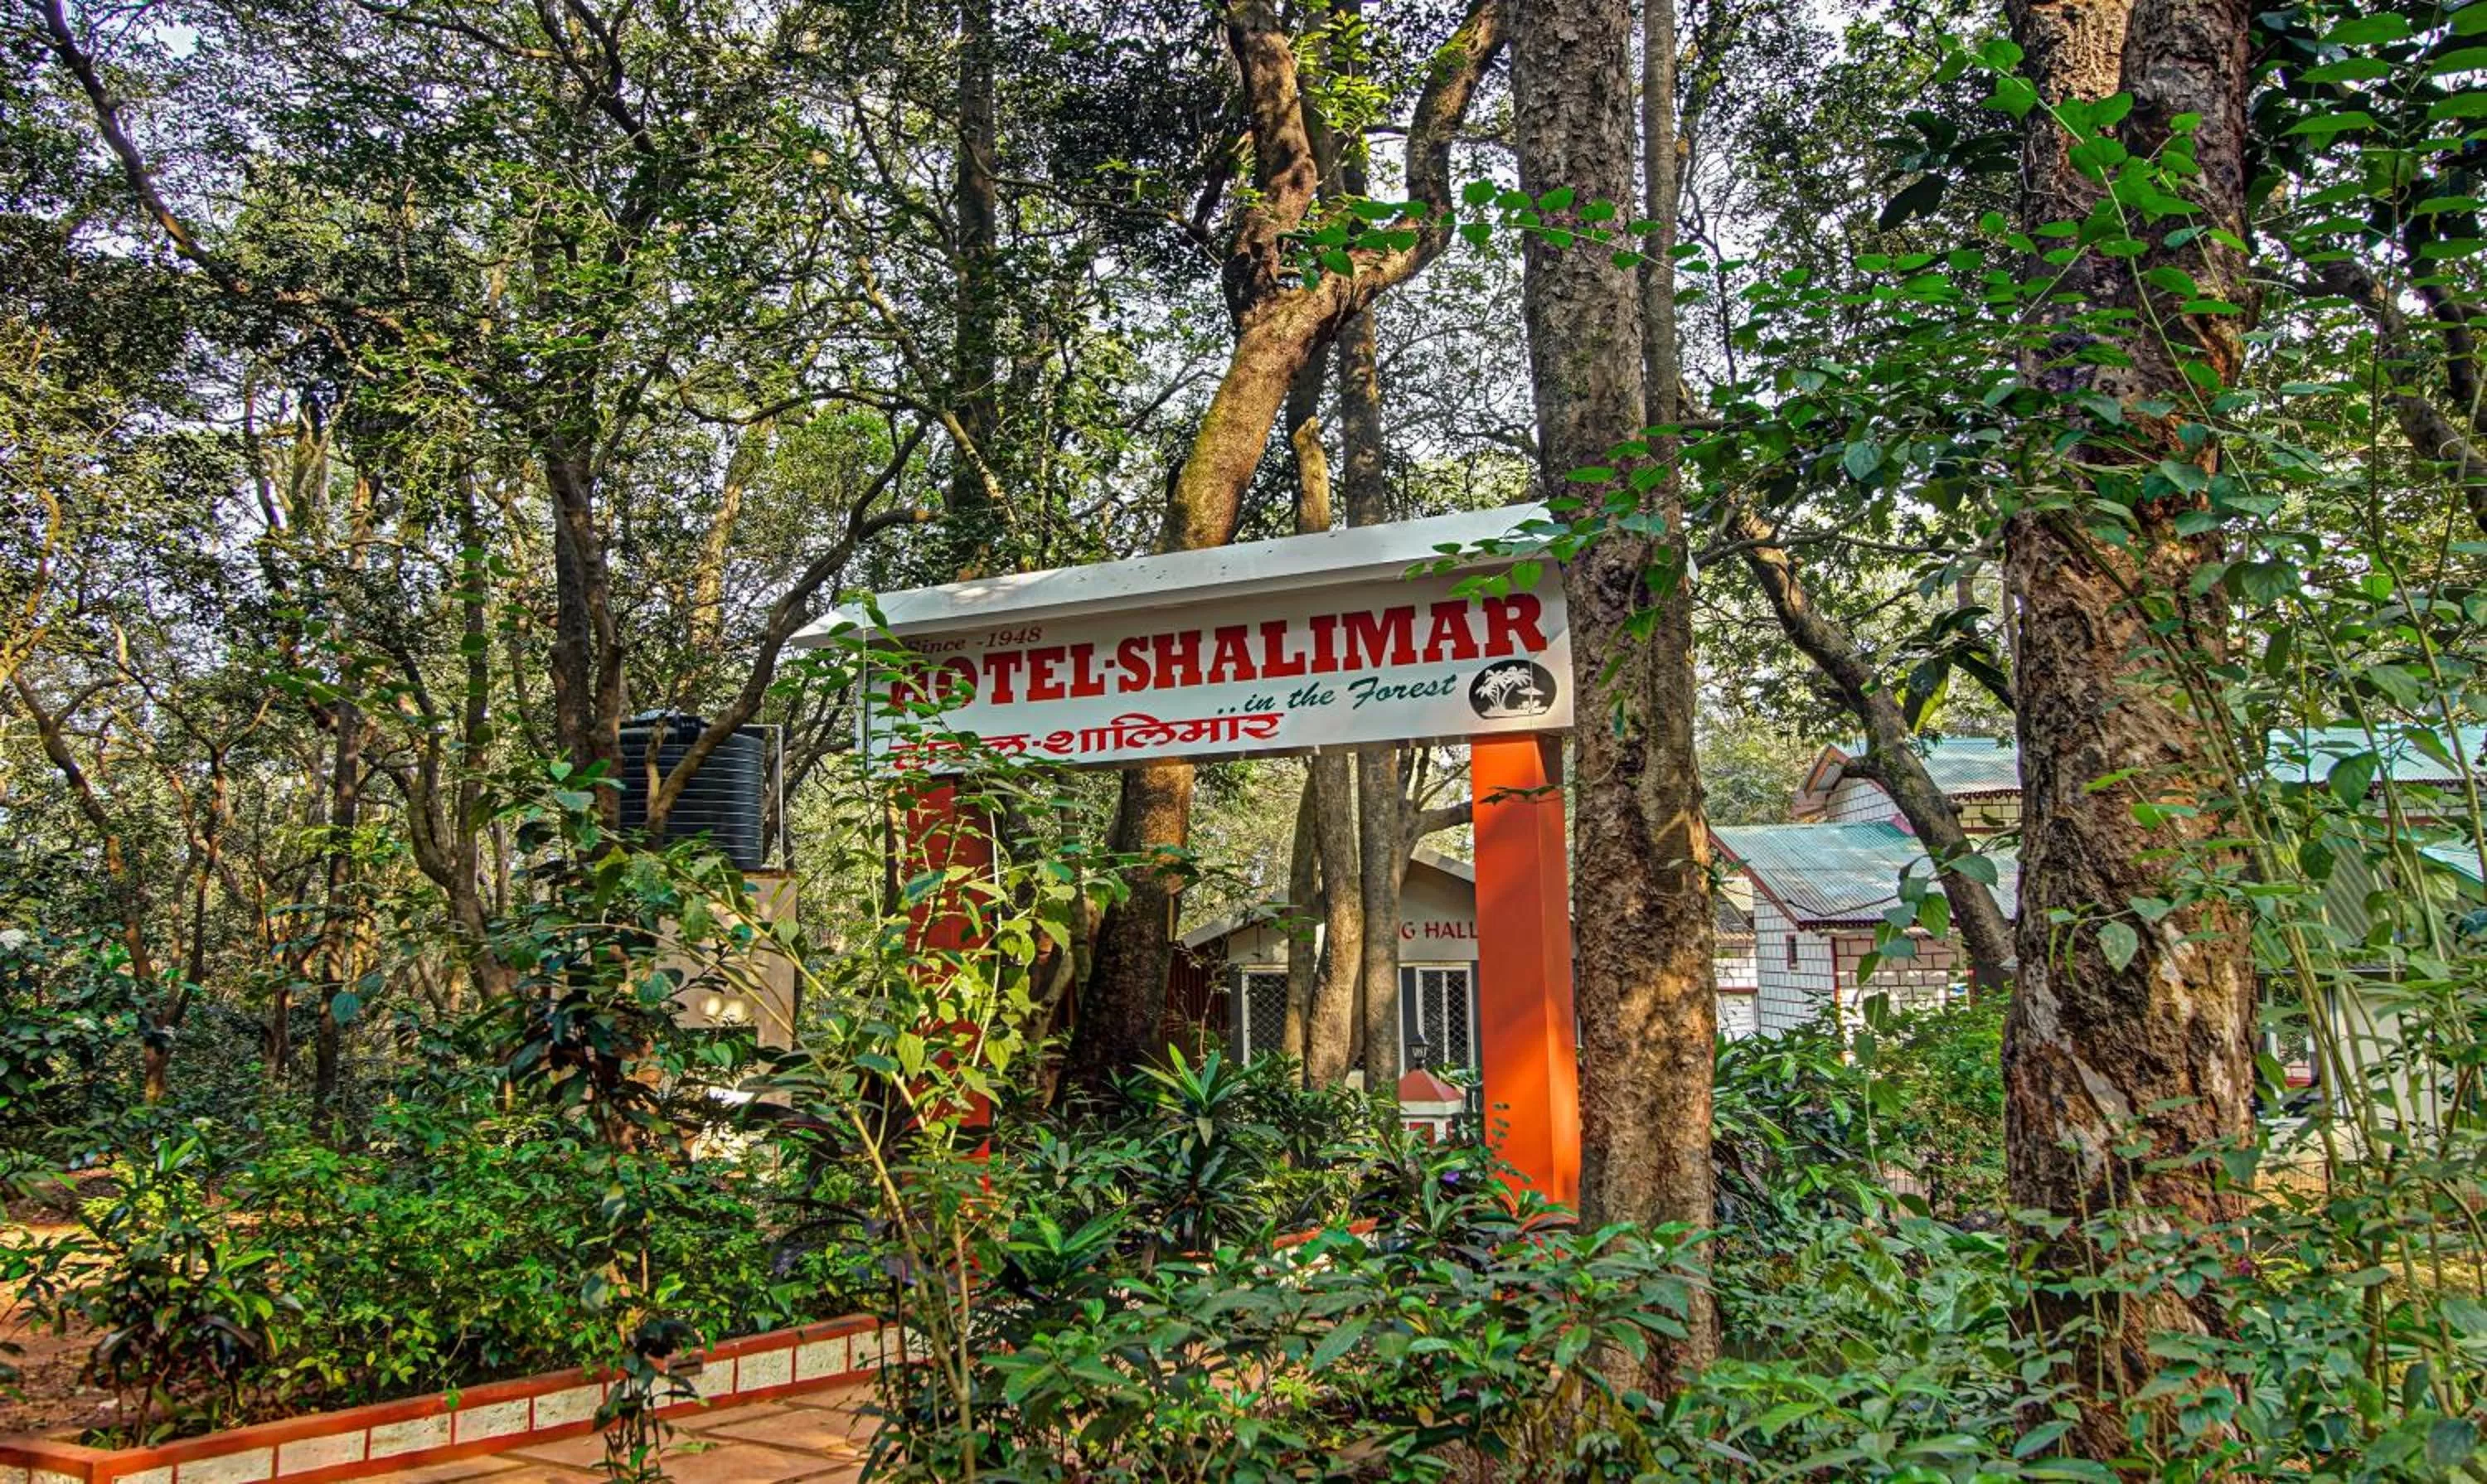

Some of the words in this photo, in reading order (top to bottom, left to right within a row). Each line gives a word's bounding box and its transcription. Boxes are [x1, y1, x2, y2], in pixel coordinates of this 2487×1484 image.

[905, 638, 966, 653] Since
[1287, 681, 1335, 709] the
[1347, 674, 1457, 710] Forest
[1397, 922, 1415, 939] G
[1424, 921, 1479, 939] HALL
